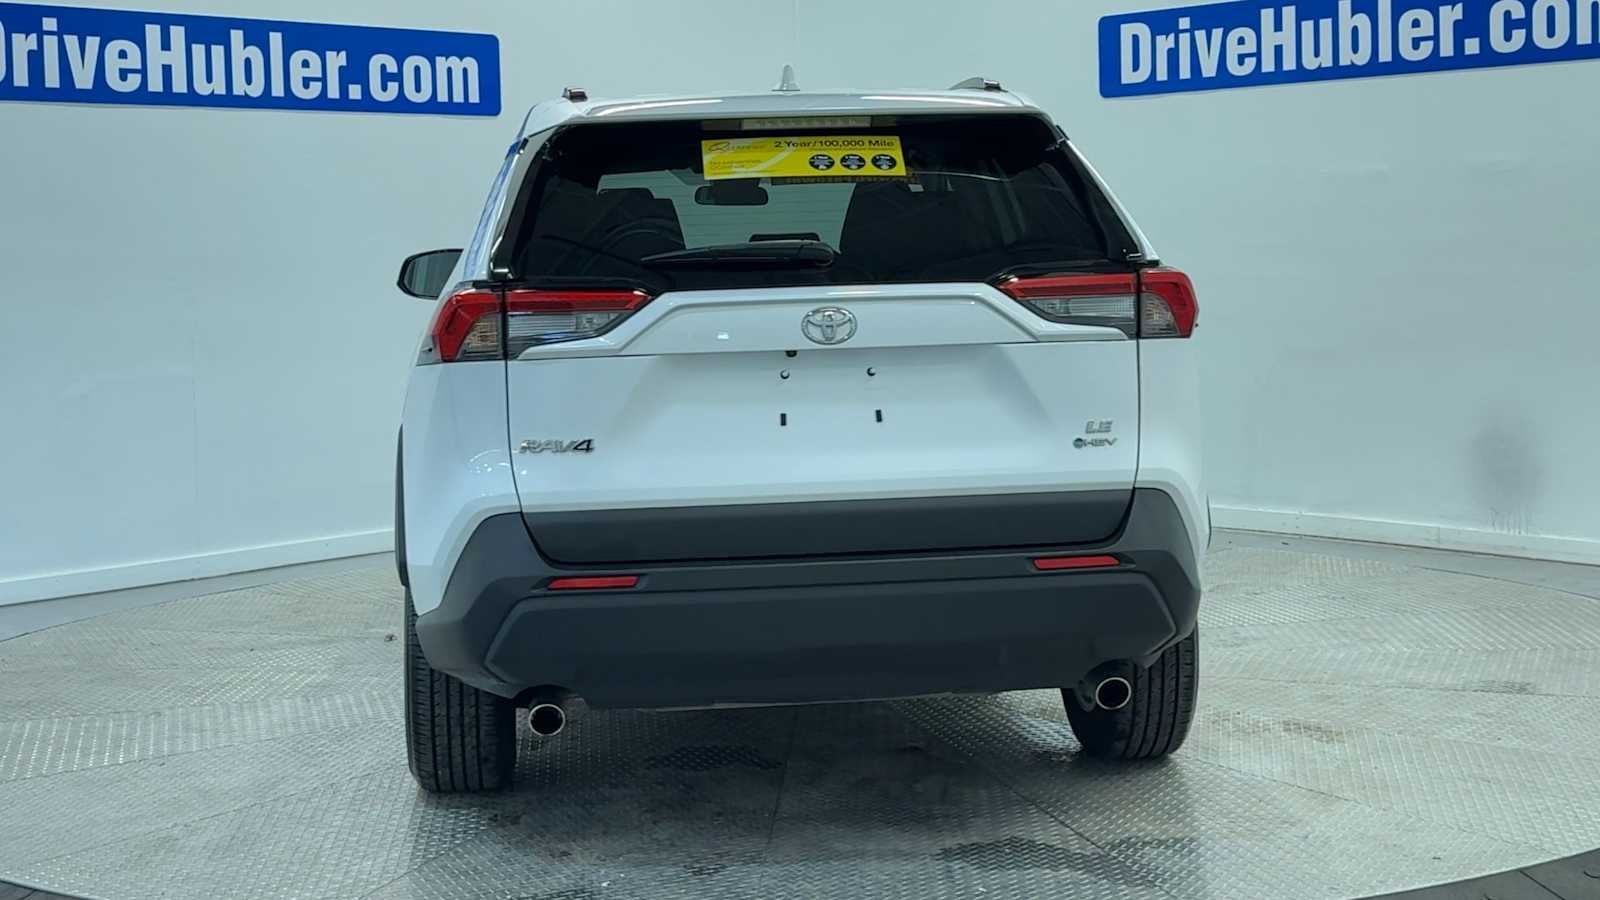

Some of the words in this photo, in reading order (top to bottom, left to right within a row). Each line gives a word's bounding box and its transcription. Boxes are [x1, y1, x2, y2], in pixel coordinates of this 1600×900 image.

[0, 16, 481, 104] riveHubler.com
[774, 140, 782, 148] 2
[868, 139, 895, 148] Mile
[1085, 420, 1113, 434] LE
[519, 438, 594, 454] RAV4
